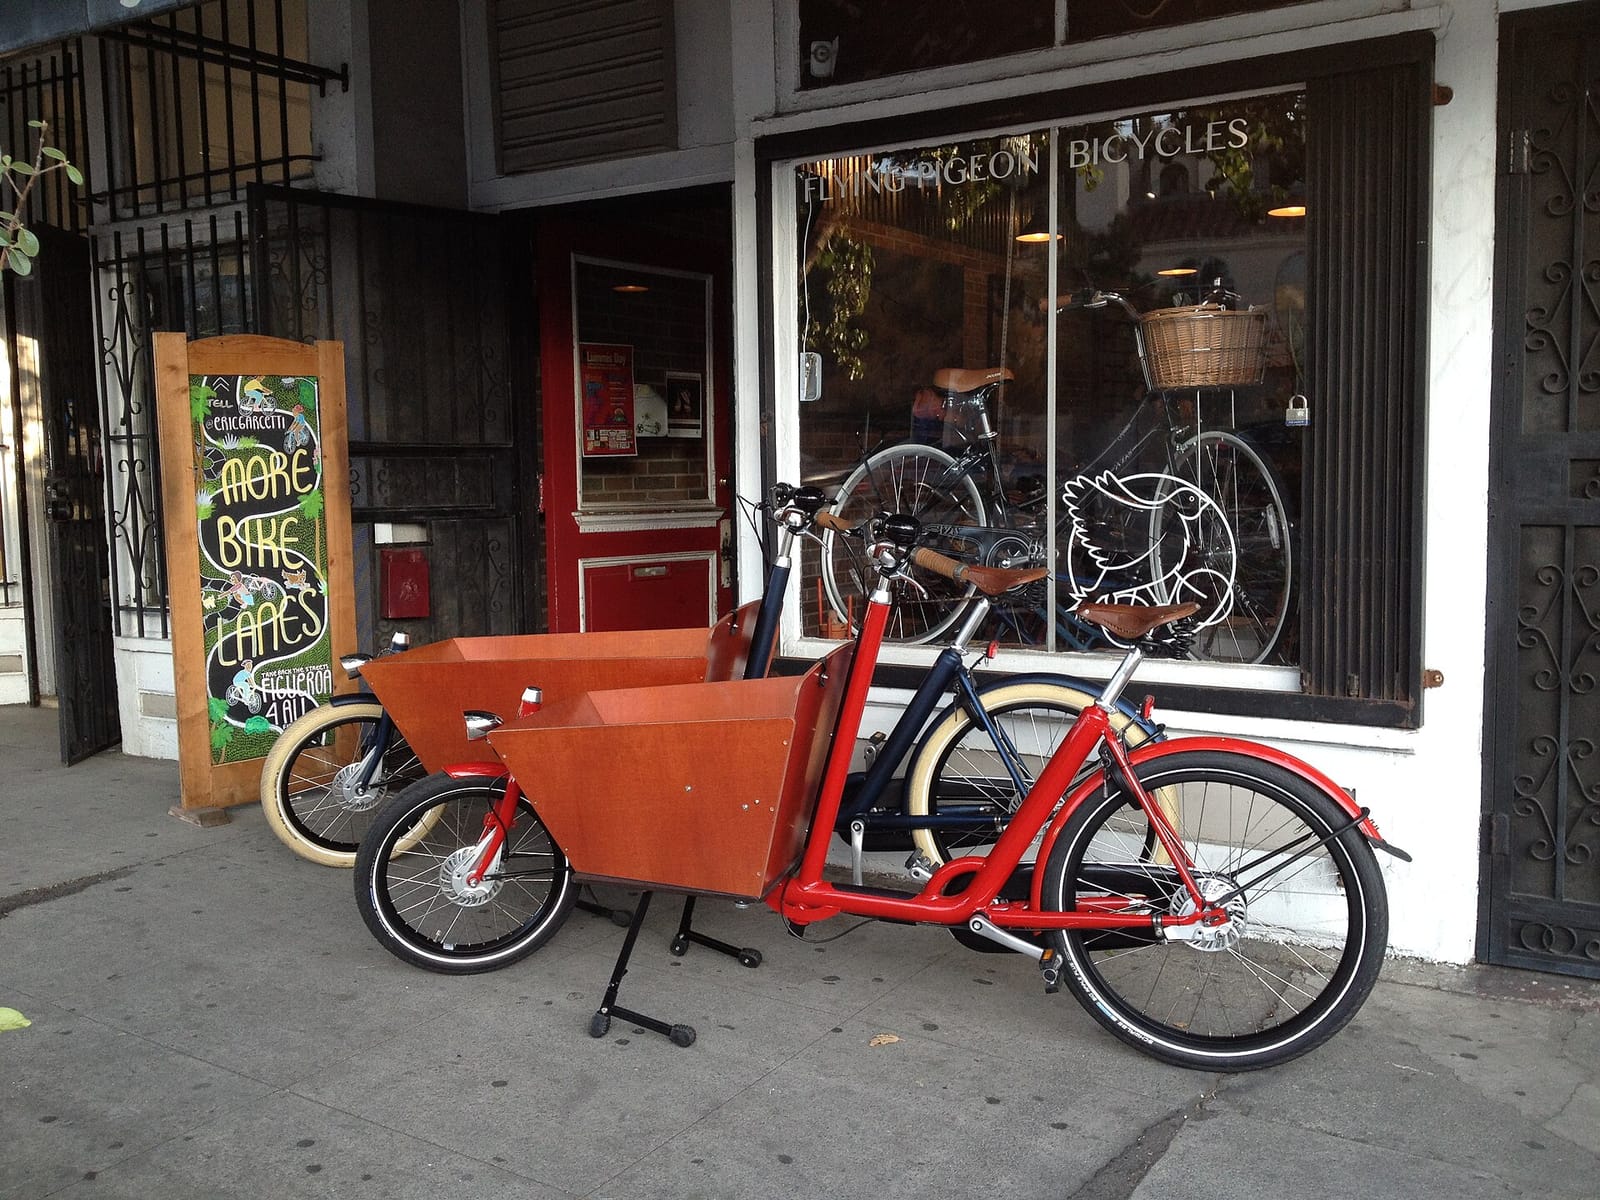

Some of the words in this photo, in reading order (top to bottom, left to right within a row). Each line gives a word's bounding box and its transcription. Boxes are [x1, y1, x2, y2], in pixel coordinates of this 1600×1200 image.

[804, 165, 906, 203] FLYING
[917, 146, 1039, 189] PIGEON
[1069, 118, 1248, 169] BICYCLES
[207, 399, 234, 408] TELL
[222, 449, 313, 505] MORE
[217, 515, 304, 570] BIKE
[217, 588, 321, 667] LANES
[261, 670, 332, 703] FIGUEROA
[277, 668, 292, 676] BACK
[265, 702, 279, 725] 4
